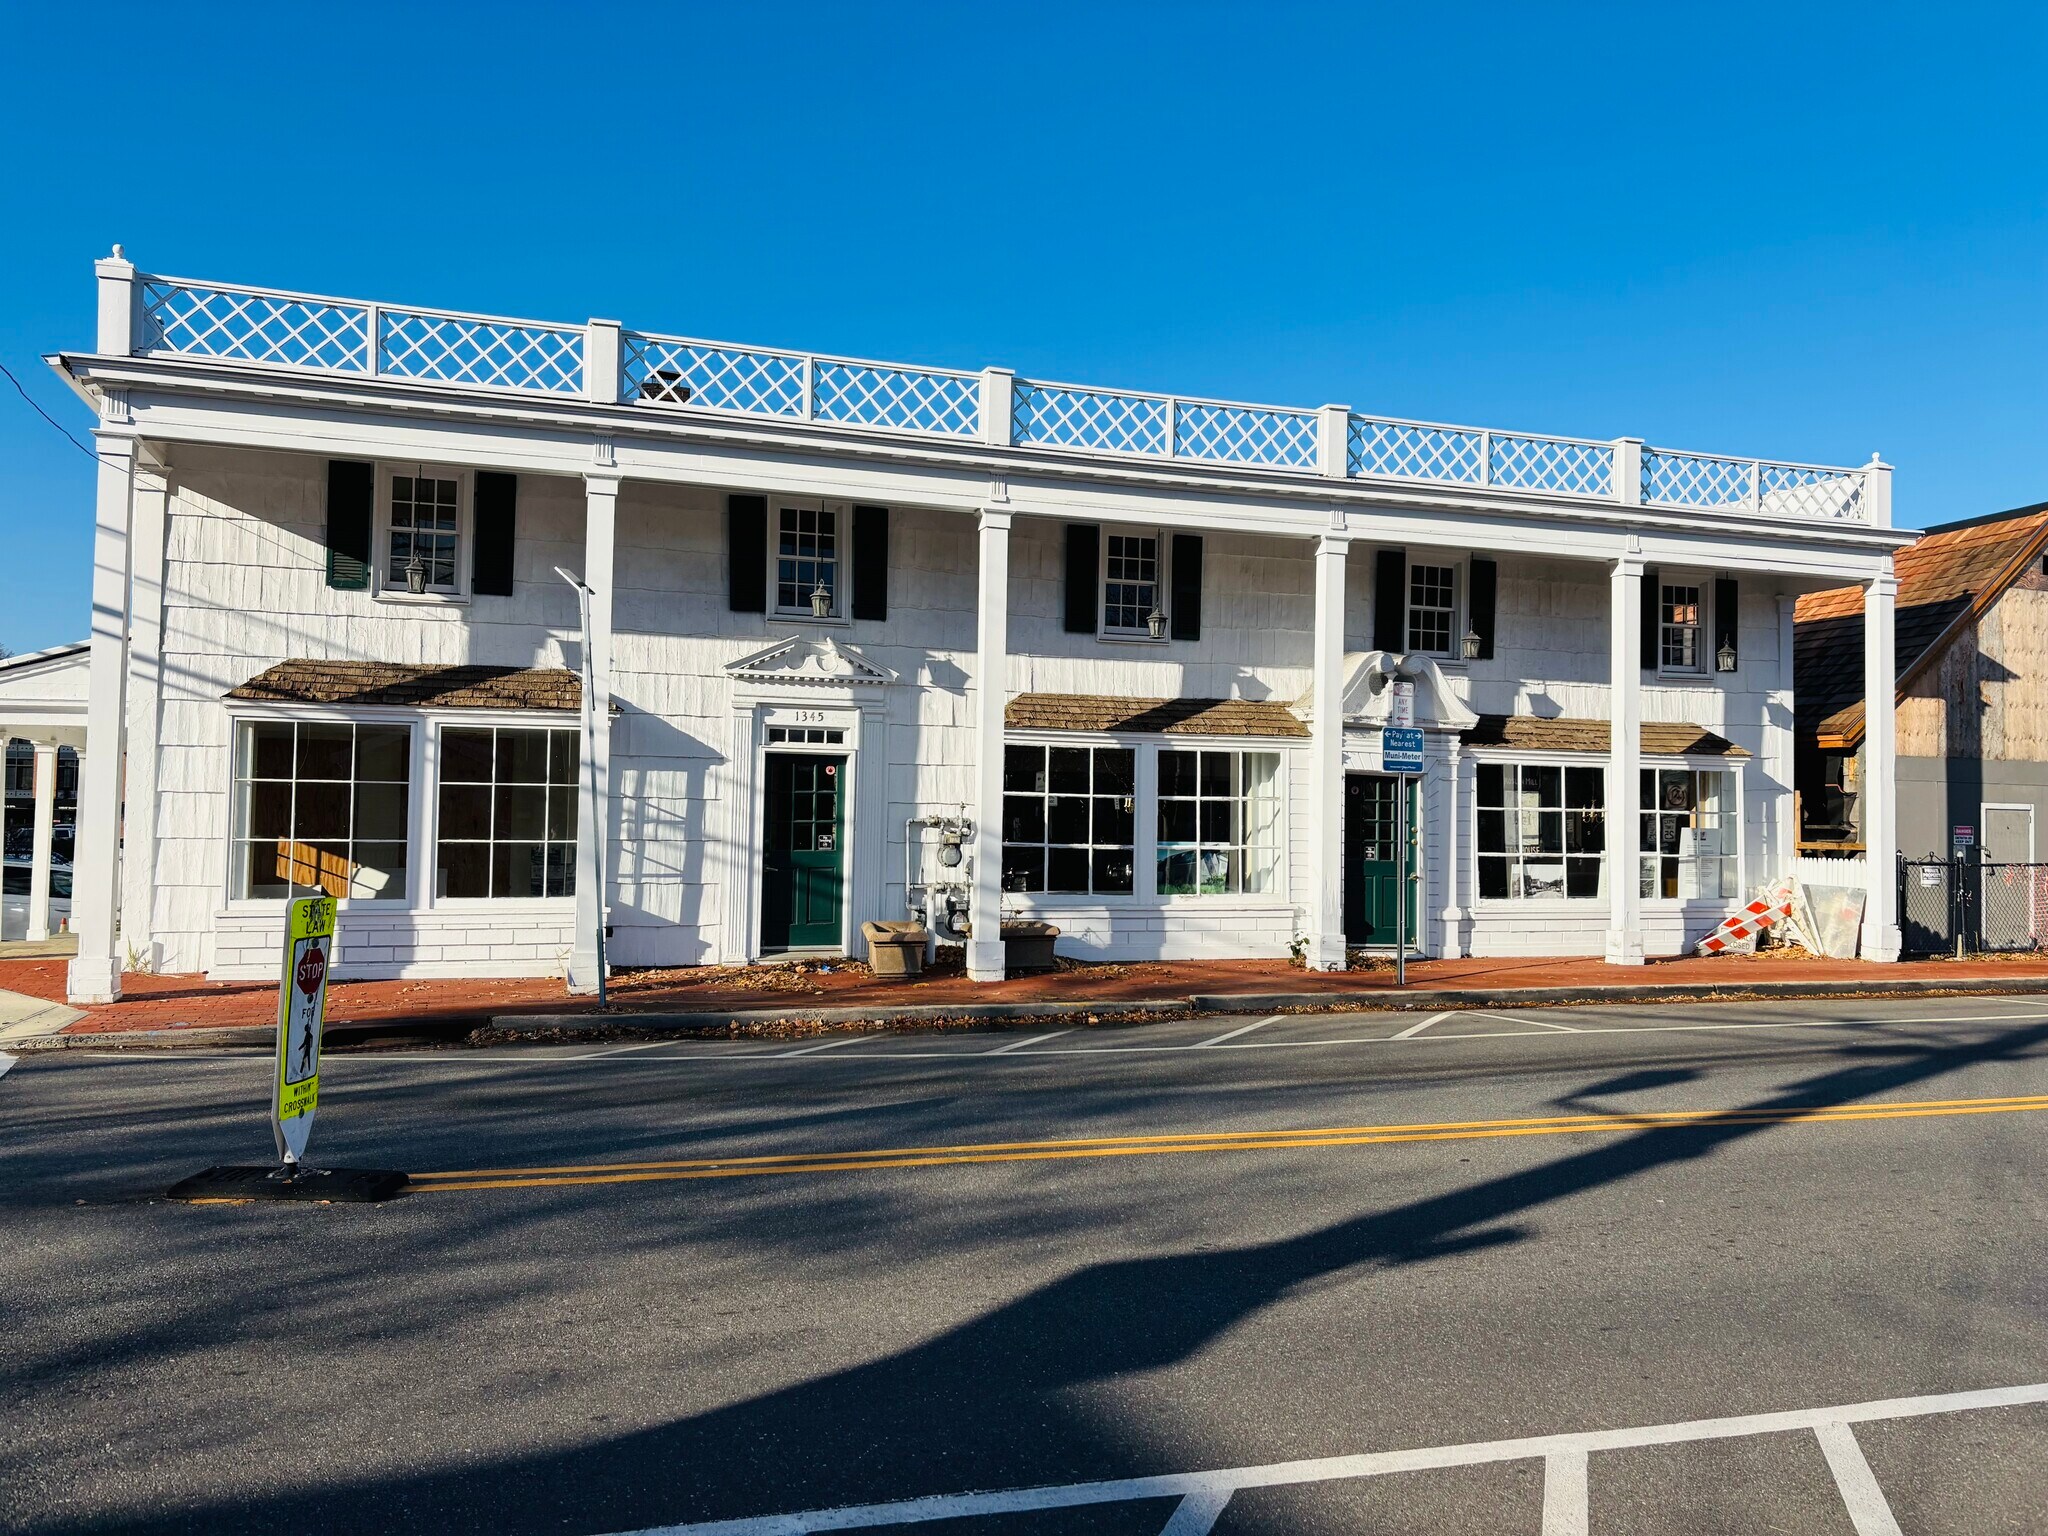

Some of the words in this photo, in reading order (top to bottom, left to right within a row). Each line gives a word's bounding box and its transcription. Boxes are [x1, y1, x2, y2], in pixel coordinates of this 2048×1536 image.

[795, 711, 824, 722] 1345
[1392, 731, 1403, 739] Pay
[1390, 739, 1416, 748] Nearest
[1385, 752, 1421, 760] Muni-Meter
[302, 903, 330, 918] STATE
[306, 920, 325, 934] LAW
[299, 962, 323, 980] STOP
[302, 1007, 314, 1019] FOR
[293, 1084, 312, 1097] WITHIN
[284, 1093, 315, 1113] CROSSWALK
